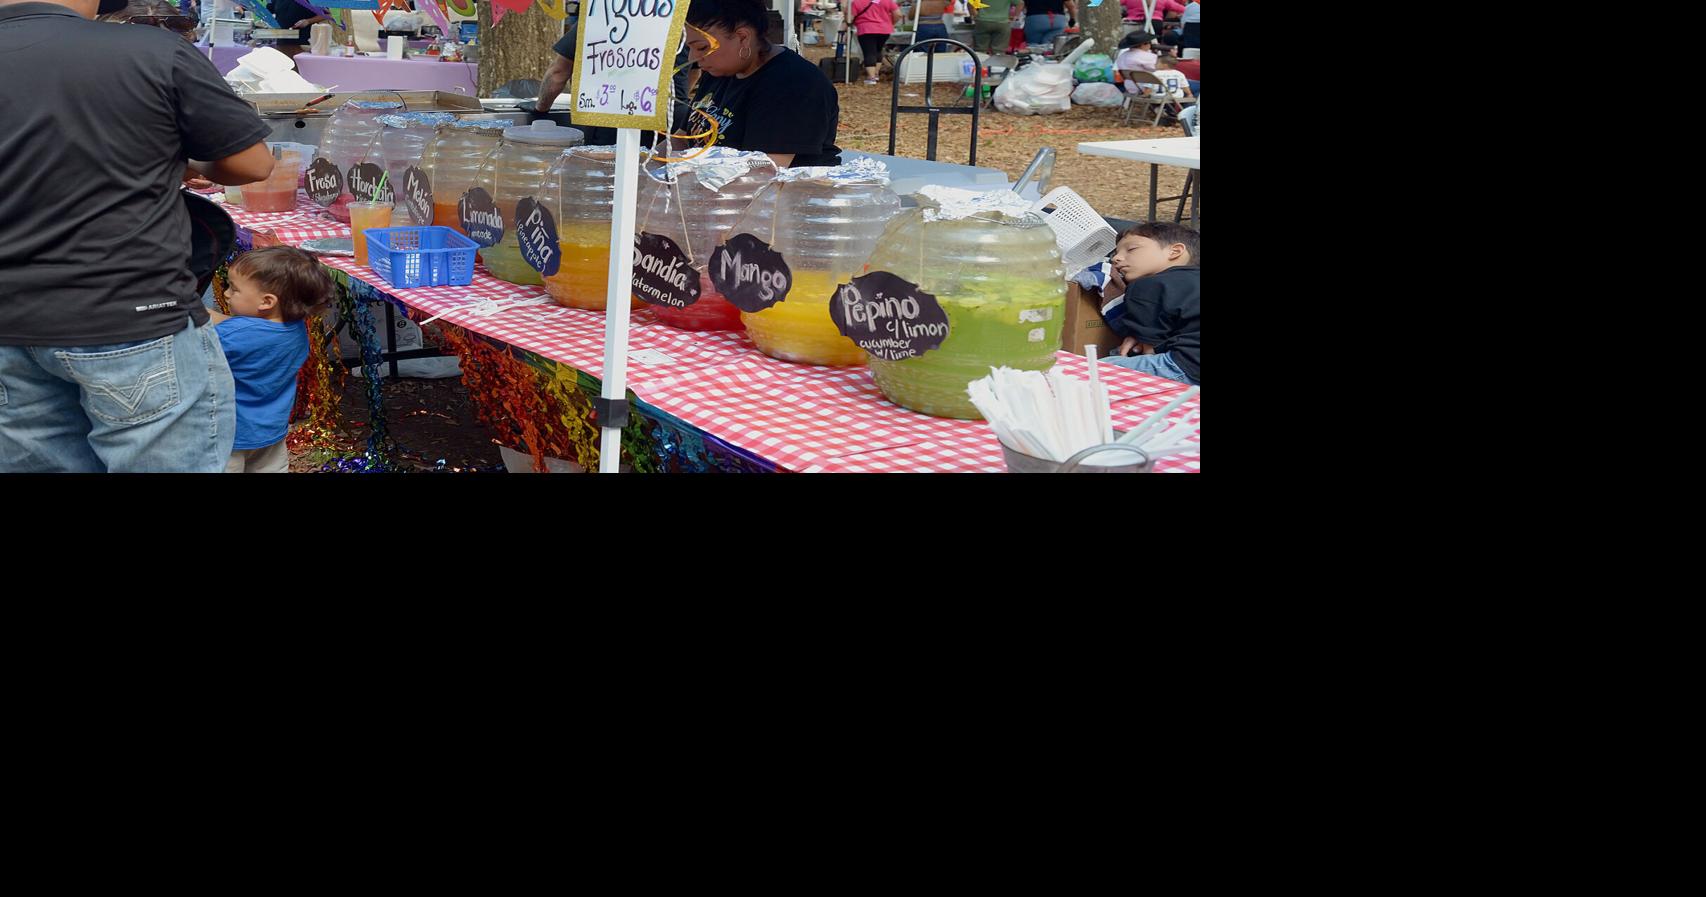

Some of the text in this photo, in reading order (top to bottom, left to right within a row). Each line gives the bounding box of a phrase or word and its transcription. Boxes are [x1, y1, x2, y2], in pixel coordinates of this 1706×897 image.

[579, 93, 596, 108] Sm.
[620, 89, 637, 115] Lg.
[306, 169, 338, 192] Fresa
[407, 171, 430, 218] Melón
[463, 197, 503, 230] Limonada
[525, 208, 553, 264] Piña
[632, 272, 685, 307] atermelon
[720, 249, 788, 300] Mango
[840, 284, 920, 333] Pepino
[860, 338, 911, 349] cucumber
